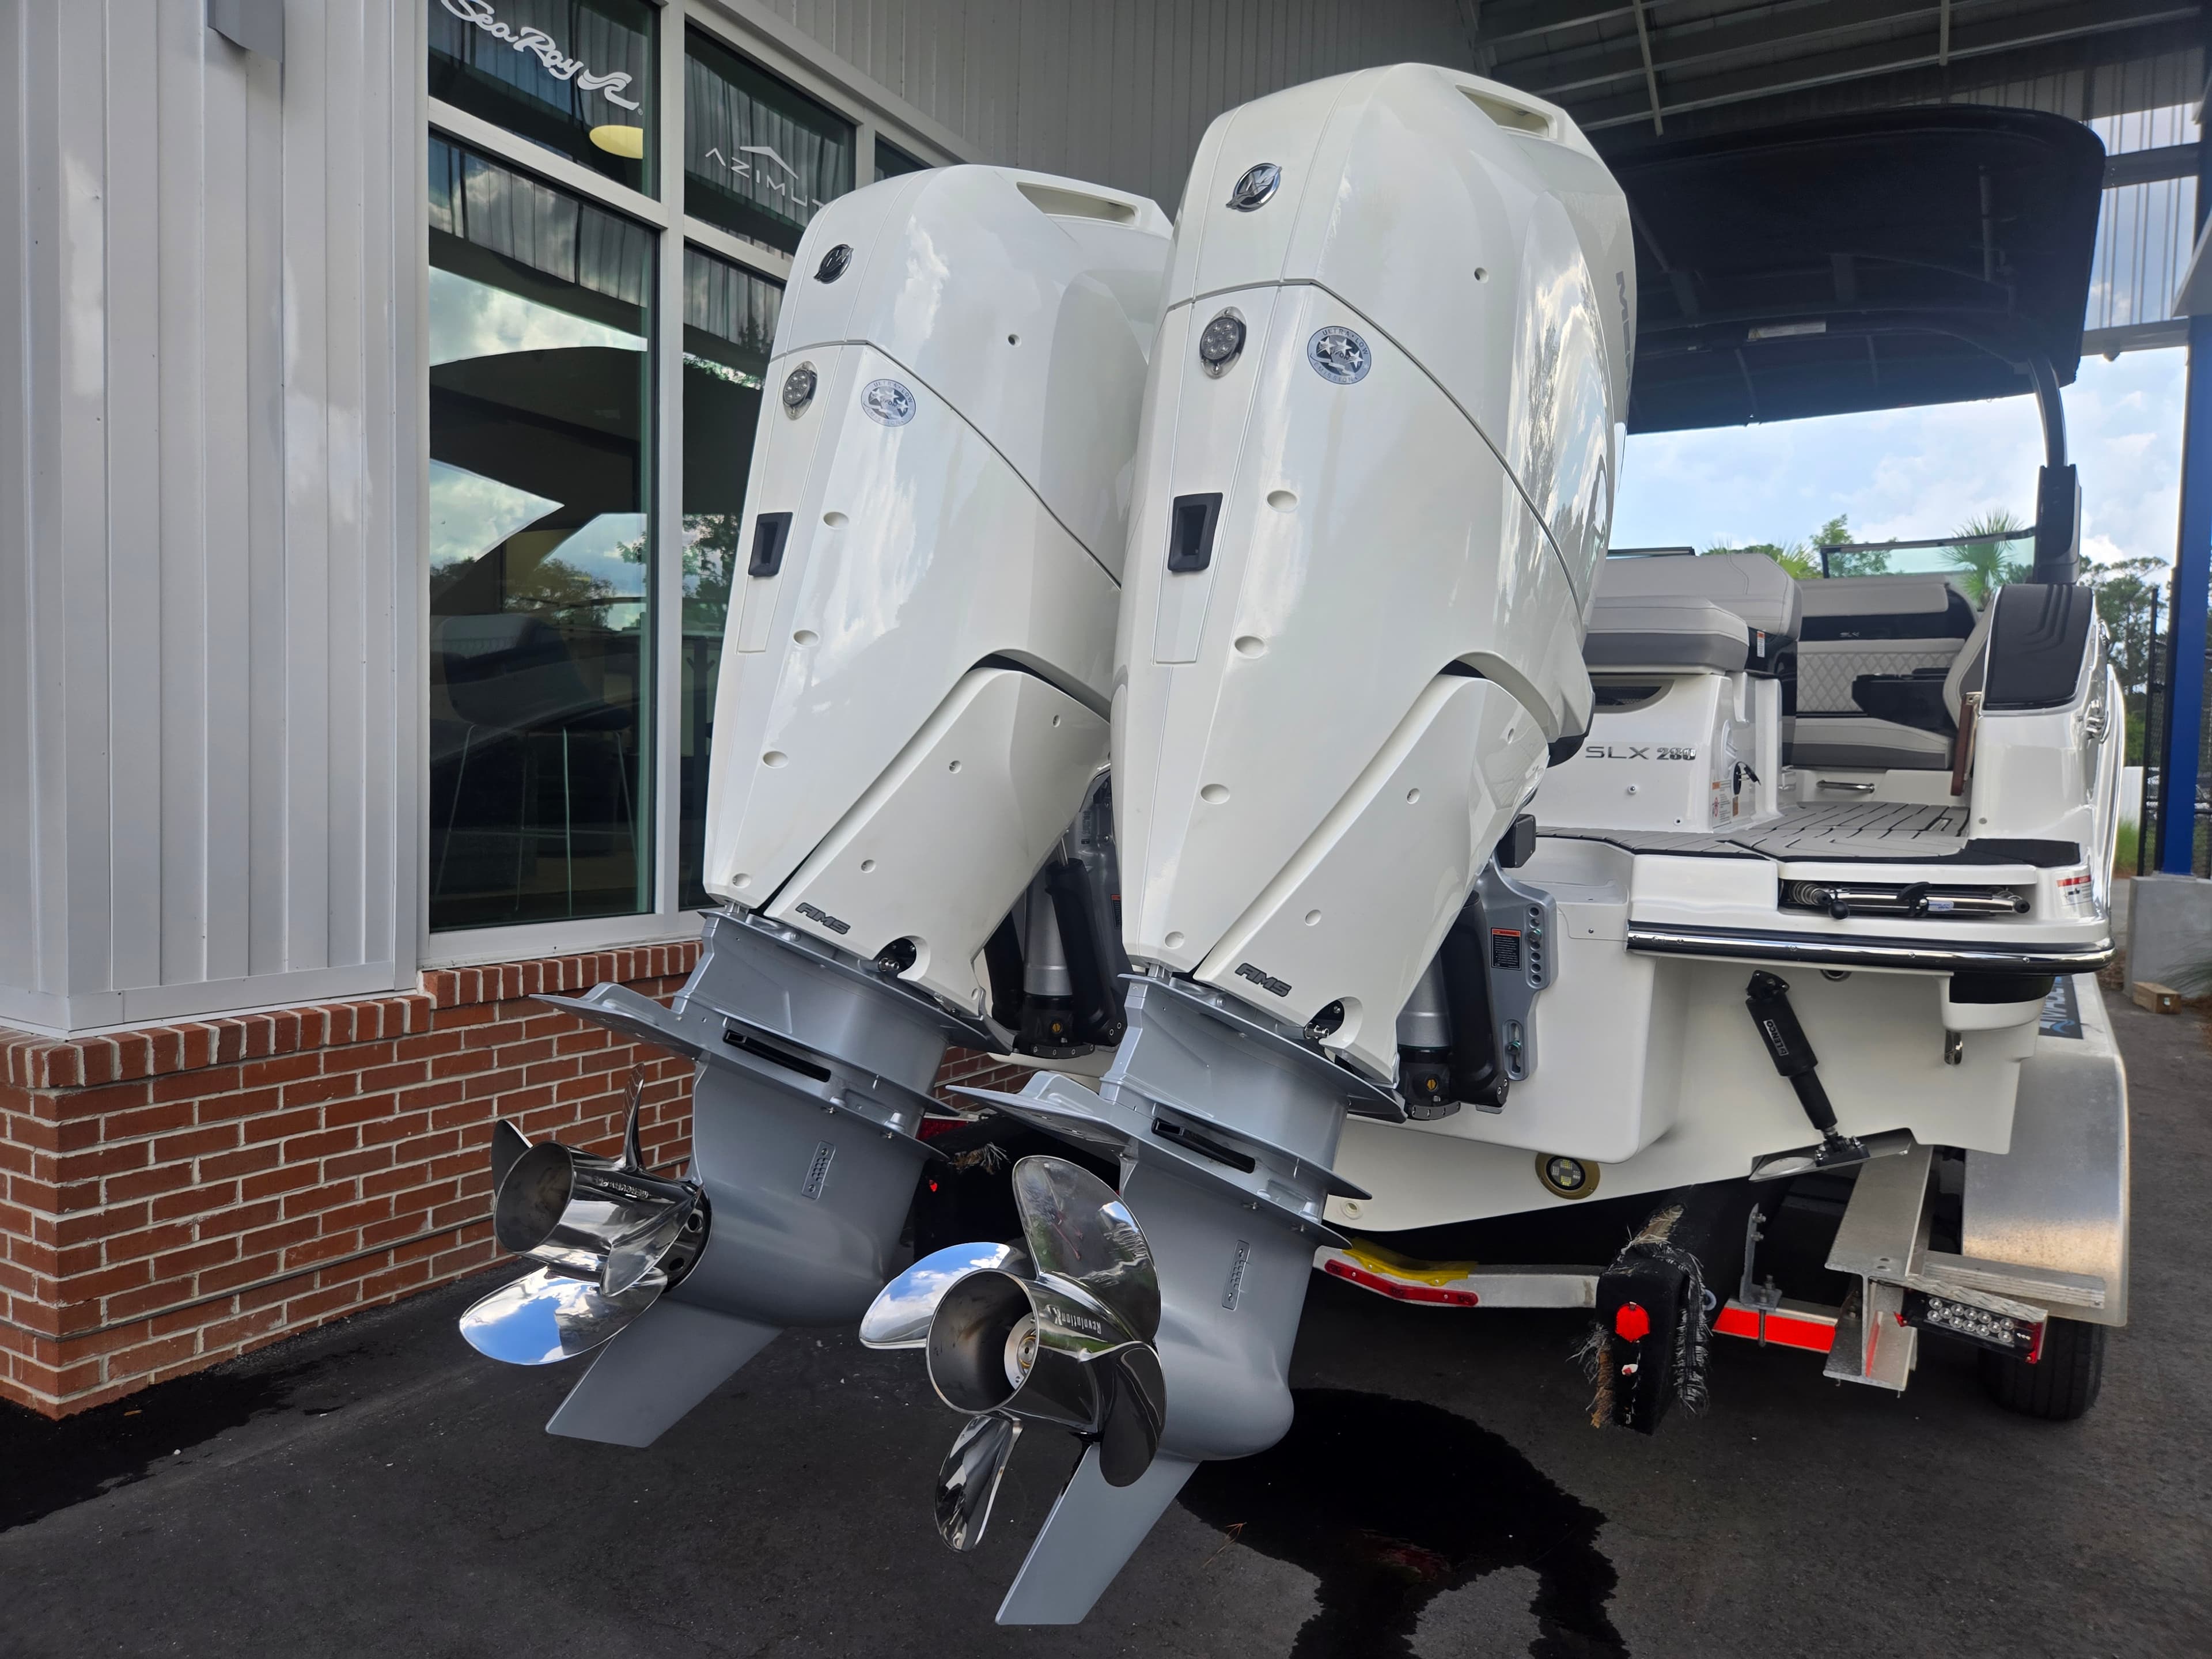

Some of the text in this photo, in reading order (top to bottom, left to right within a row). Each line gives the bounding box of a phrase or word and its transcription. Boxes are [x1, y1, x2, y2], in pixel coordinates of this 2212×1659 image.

[440, 0, 584, 80] Sea Ray
[1355, 337, 1369, 355] LOW
[1585, 747, 1650, 760] SLX
[796, 902, 851, 935] AMS
[1234, 963, 1292, 997] AMS
[1766, 1020, 1784, 1048] LENCO
